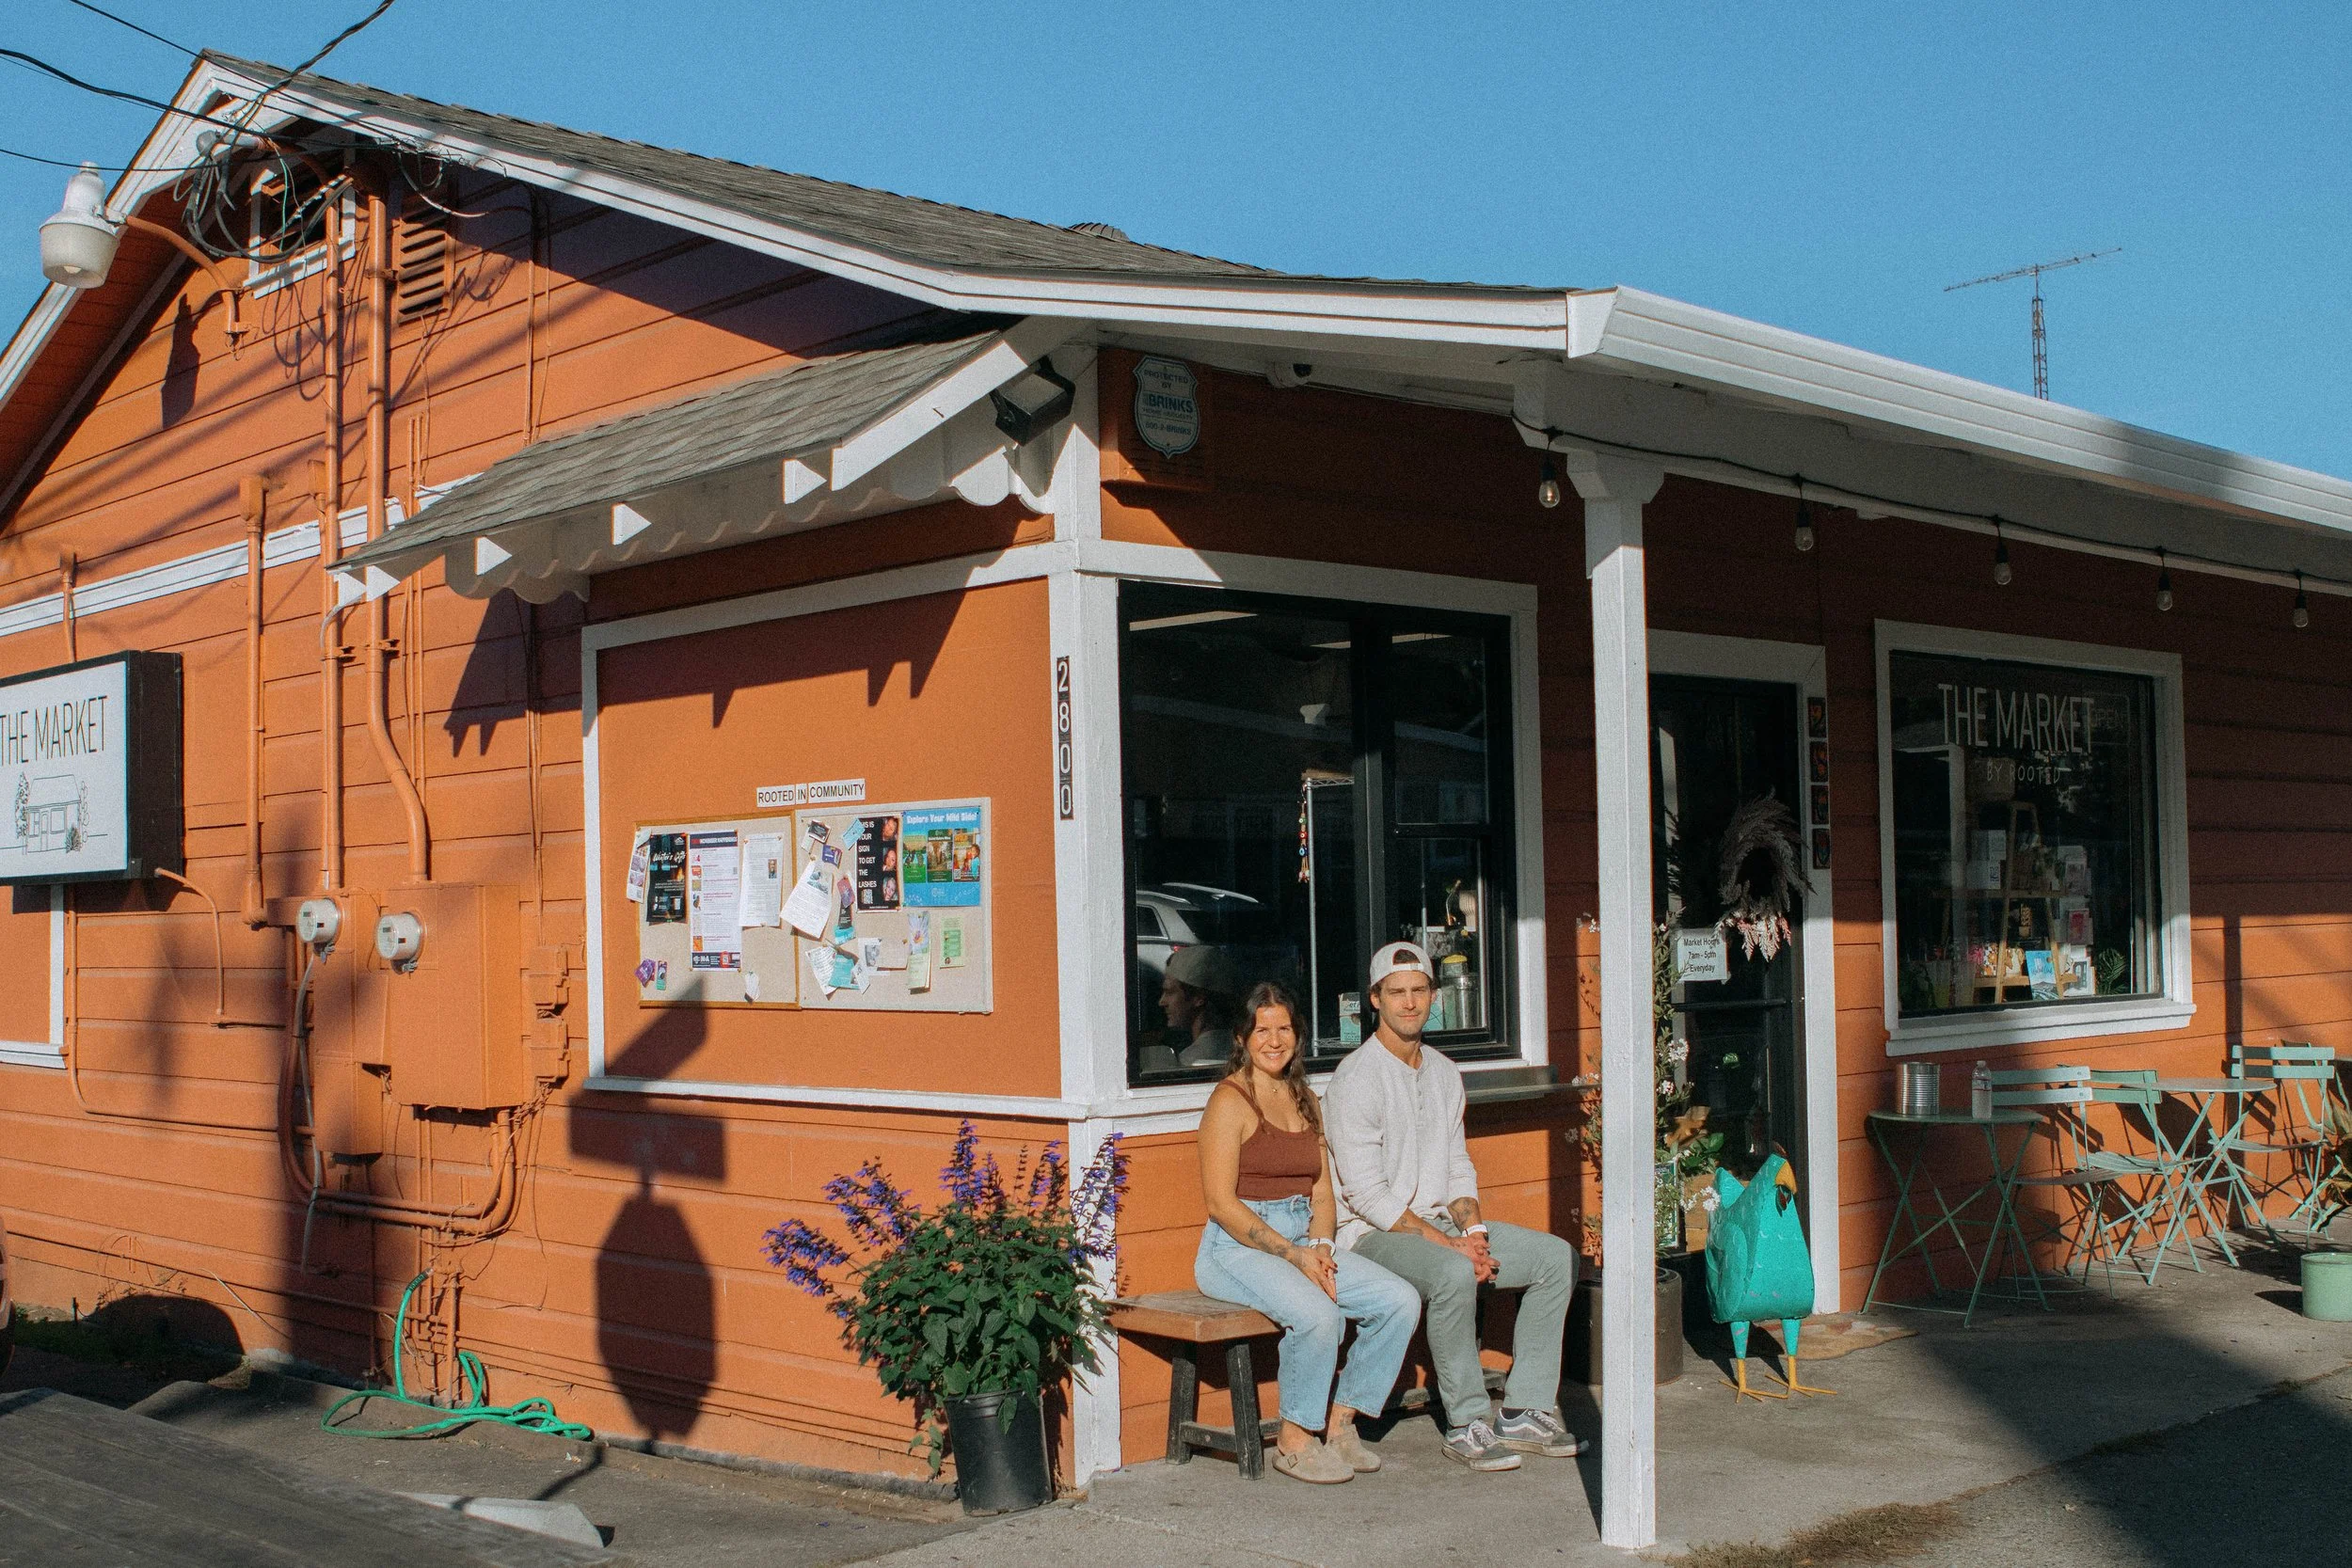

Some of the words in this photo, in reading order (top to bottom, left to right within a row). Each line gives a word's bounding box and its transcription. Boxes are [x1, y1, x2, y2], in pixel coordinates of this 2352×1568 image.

[1143, 369, 1188, 384] PROTECTED
[1149, 394, 1193, 413] BRINKS
[1937, 683, 1989, 747] THE
[1995, 689, 2095, 754] MARKET
[0, 710, 29, 767] THE
[35, 695, 108, 761] MARKET
[1057, 660, 1072, 816] 2800
[1987, 761, 2002, 783] BY
[2010, 765, 2060, 785] ROOTED
[757, 789, 794, 803] ROOTED
[798, 788, 806, 800] IN
[809, 784, 864, 799] COMMUNITY
[868, 820, 875, 829] IS
[907, 816, 929, 825] Explore
[930, 814, 945, 822] Your
[946, 813, 960, 822] Wild
[961, 812, 977, 821] Side!
[1683, 938, 1702, 946] Market
[1688, 951, 1700, 959] 7am
[1704, 950, 1717, 960] 5pm
[1690, 964, 1716, 974] Everyday
